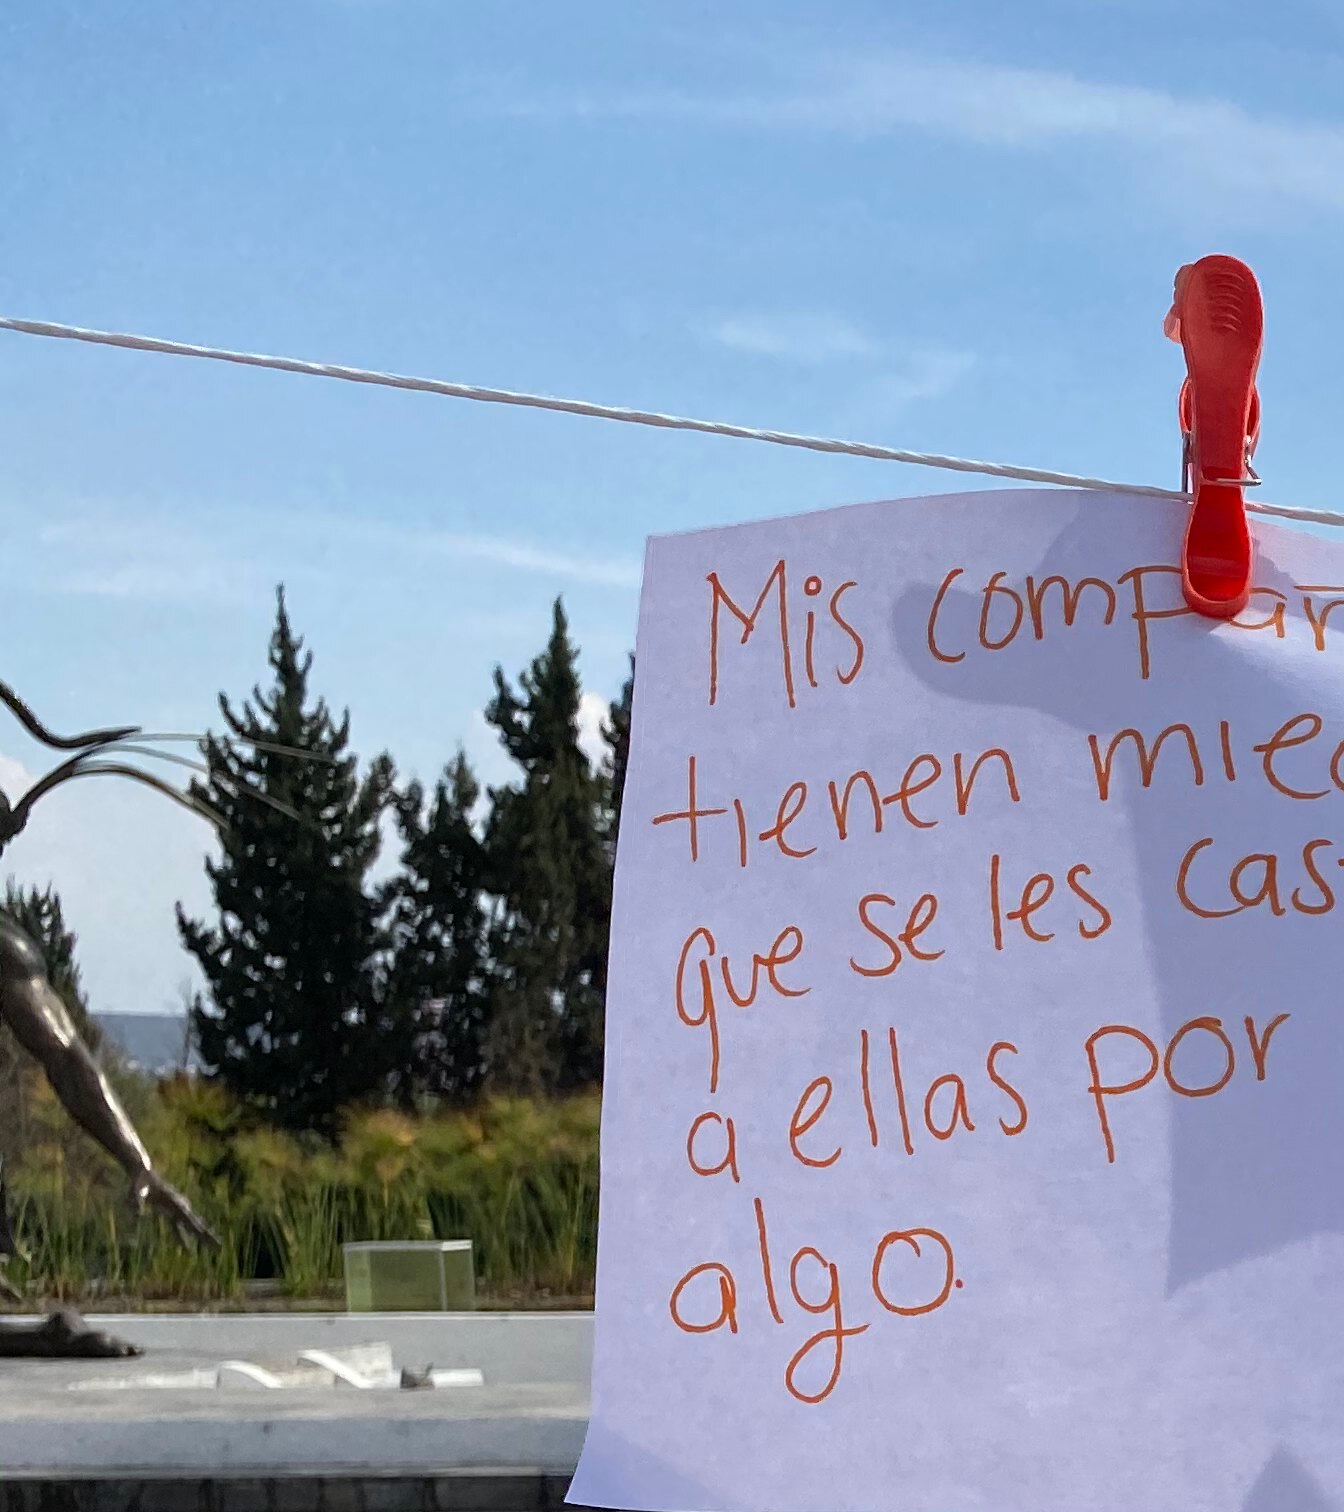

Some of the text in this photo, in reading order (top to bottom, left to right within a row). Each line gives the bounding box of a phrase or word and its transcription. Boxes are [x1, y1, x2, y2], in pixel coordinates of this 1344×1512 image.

[707, 558, 864, 709] Mis
[652, 748, 1021, 868] tienen
[675, 925, 812, 1094] que
[849, 893, 947, 977] se
[989, 853, 1112, 950] les
[686, 1110, 741, 1183] a
[787, 1025, 1028, 1168] ellas
[1084, 1012, 1291, 1164] por
[668, 1197, 965, 1404] algo.
